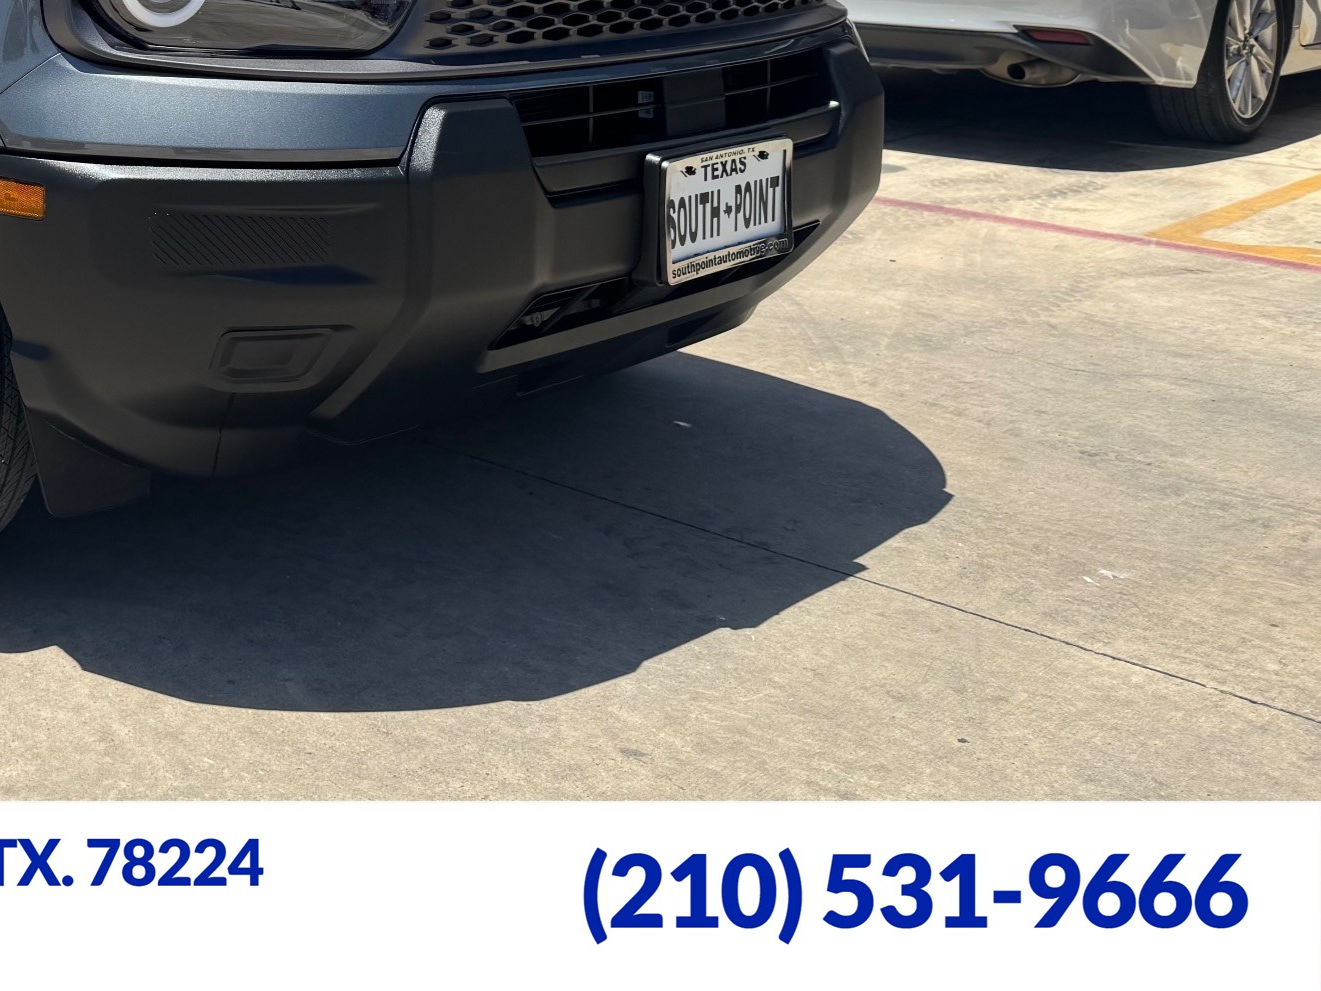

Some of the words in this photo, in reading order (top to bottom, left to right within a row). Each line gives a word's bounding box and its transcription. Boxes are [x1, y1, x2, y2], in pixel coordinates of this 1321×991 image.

[700, 155, 714, 163] SAN
[700, 156, 747, 182] TEXAS
[668, 188, 721, 250] SOUTH
[734, 175, 780, 232] POINT
[671, 237, 789, 279] southpointautomotive.com
